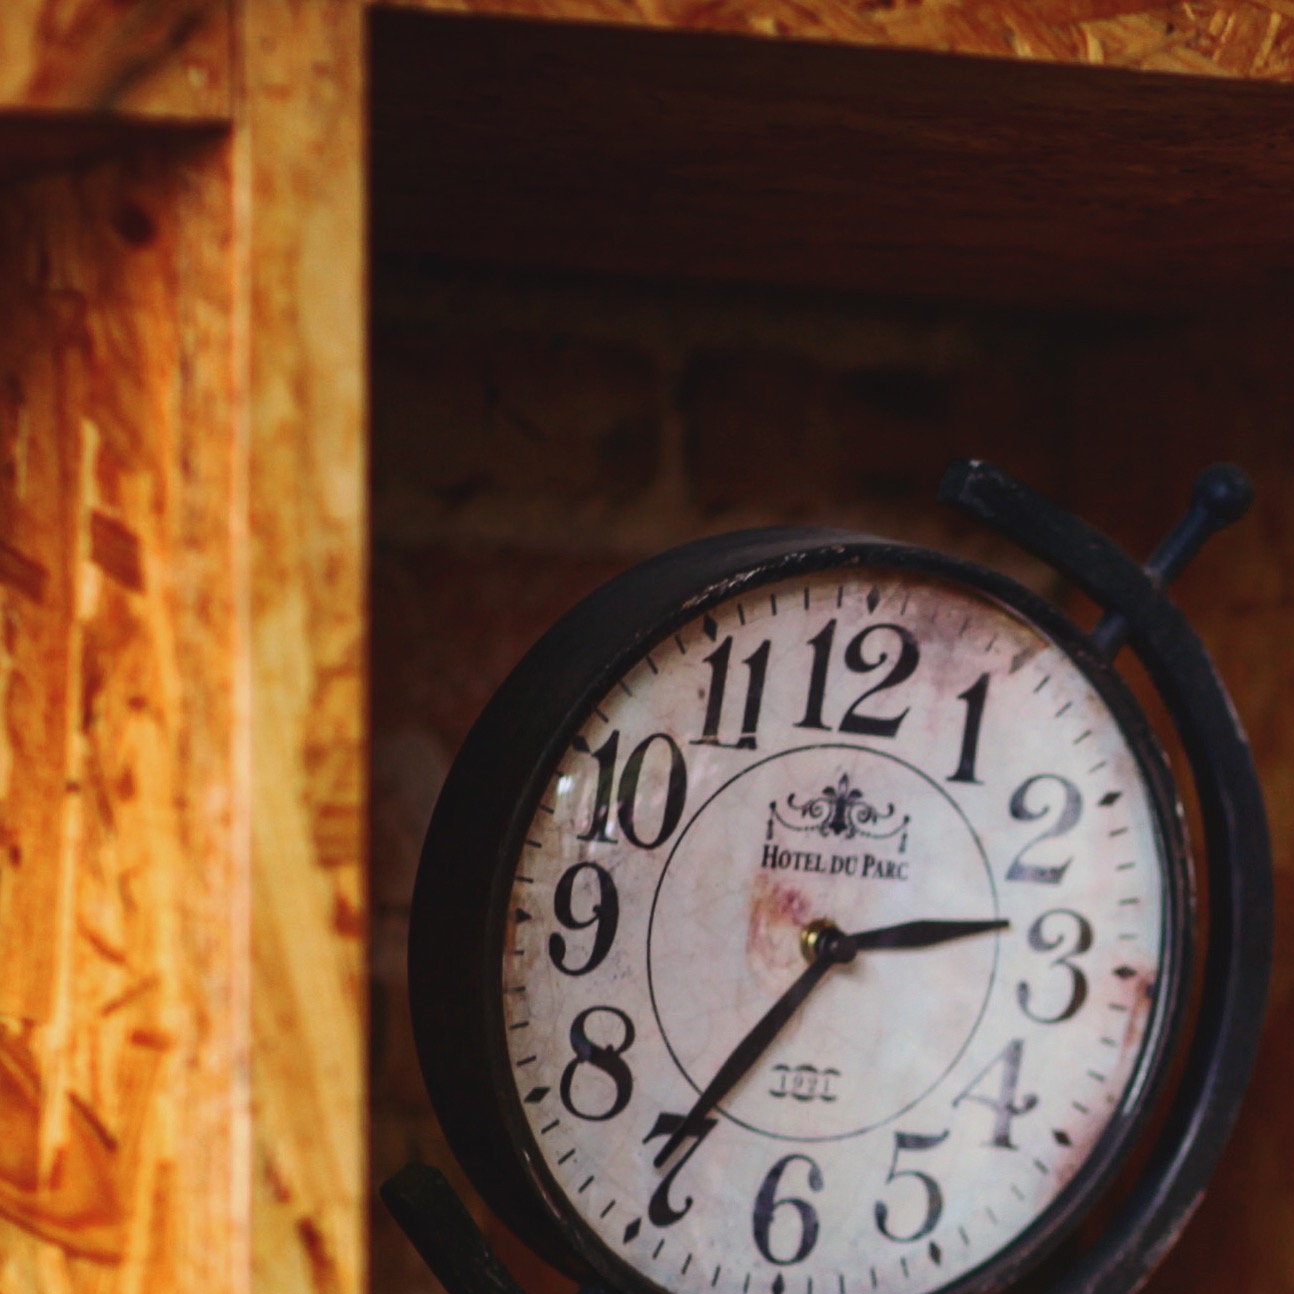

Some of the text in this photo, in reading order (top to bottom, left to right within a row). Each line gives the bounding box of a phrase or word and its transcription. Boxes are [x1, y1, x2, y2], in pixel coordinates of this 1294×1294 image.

[689, 635, 772, 750] 11
[794, 619, 920, 739] 12
[946, 672, 991, 785] 1
[576, 729, 687, 850] 10
[1005, 773, 1083, 885] 2
[548, 862, 620, 977] 9
[761, 844, 910, 880] HOTEL DU PARC
[1016, 909, 1093, 1023] 3
[560, 1006, 636, 1121] 8
[953, 1039, 1038, 1151] 4
[642, 1111, 719, 1228] 7
[751, 1153, 824, 1266] 6
[874, 1128, 951, 1243] 5
